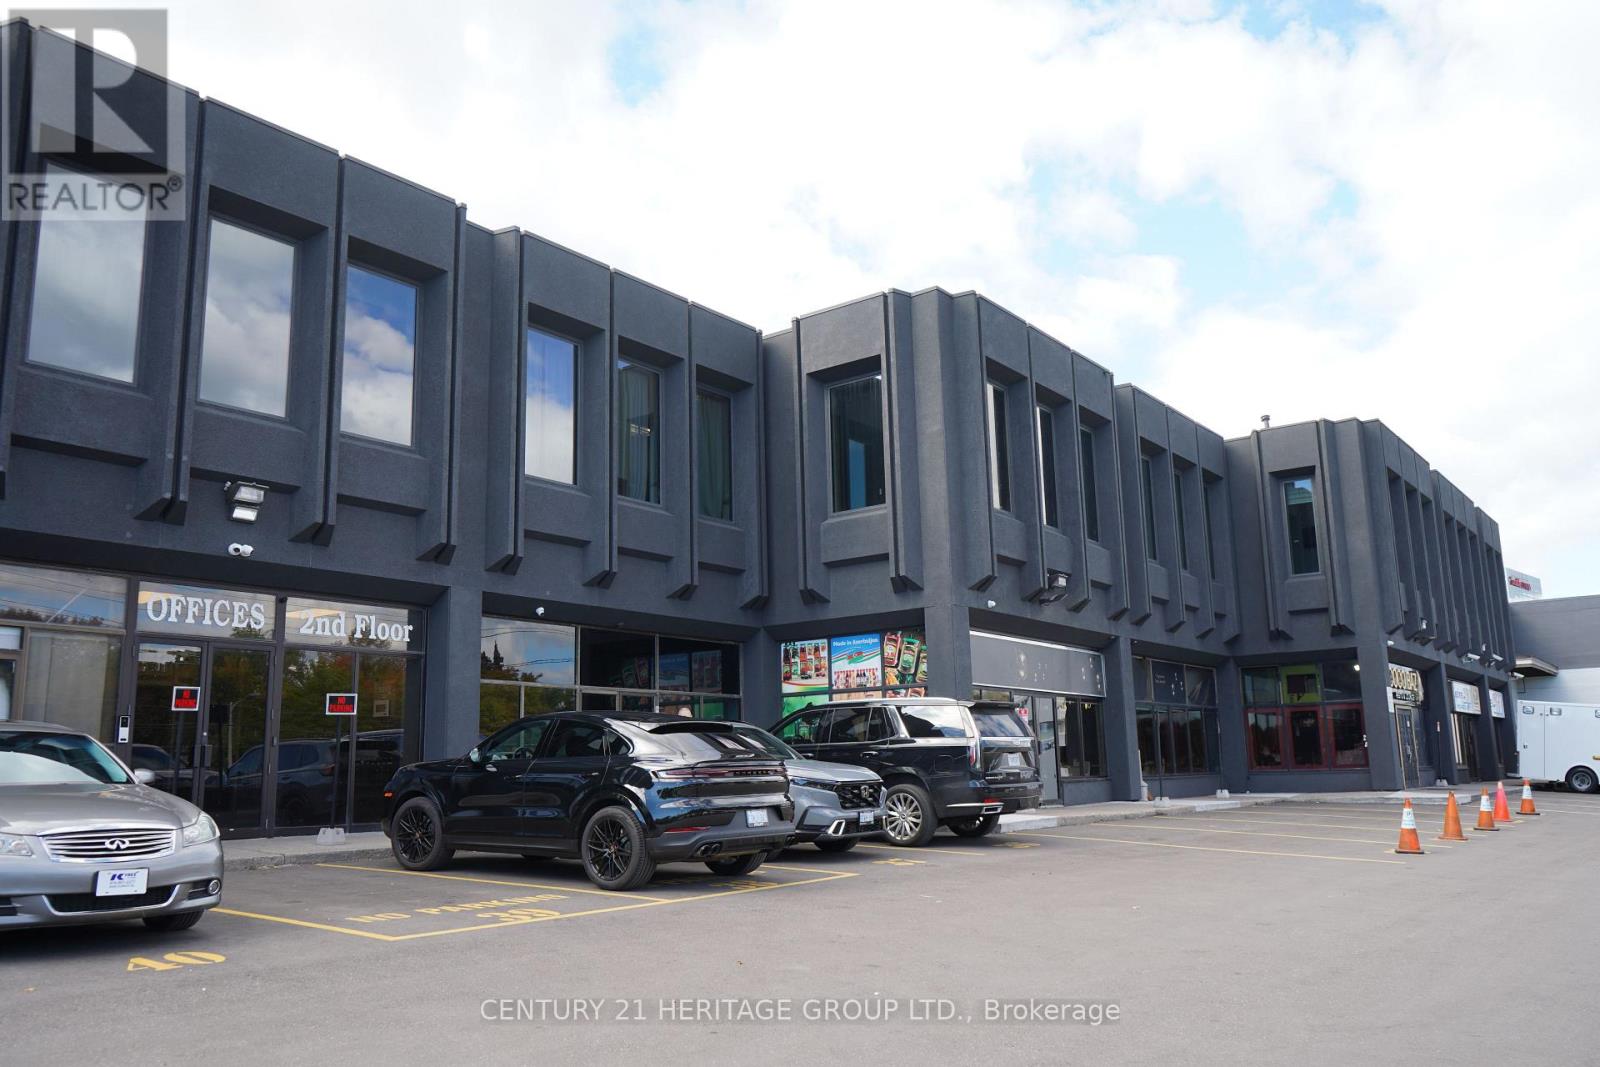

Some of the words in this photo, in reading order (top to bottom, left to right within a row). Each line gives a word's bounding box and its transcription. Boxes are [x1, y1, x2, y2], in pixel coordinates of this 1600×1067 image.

[146, 595, 266, 630] OFFICES
[300, 609, 346, 637] 2nd
[354, 614, 414, 642] Floor
[344, 912, 412, 923] NO
[415, 894, 570, 915] PARKING
[127, 951, 226, 971] 40
